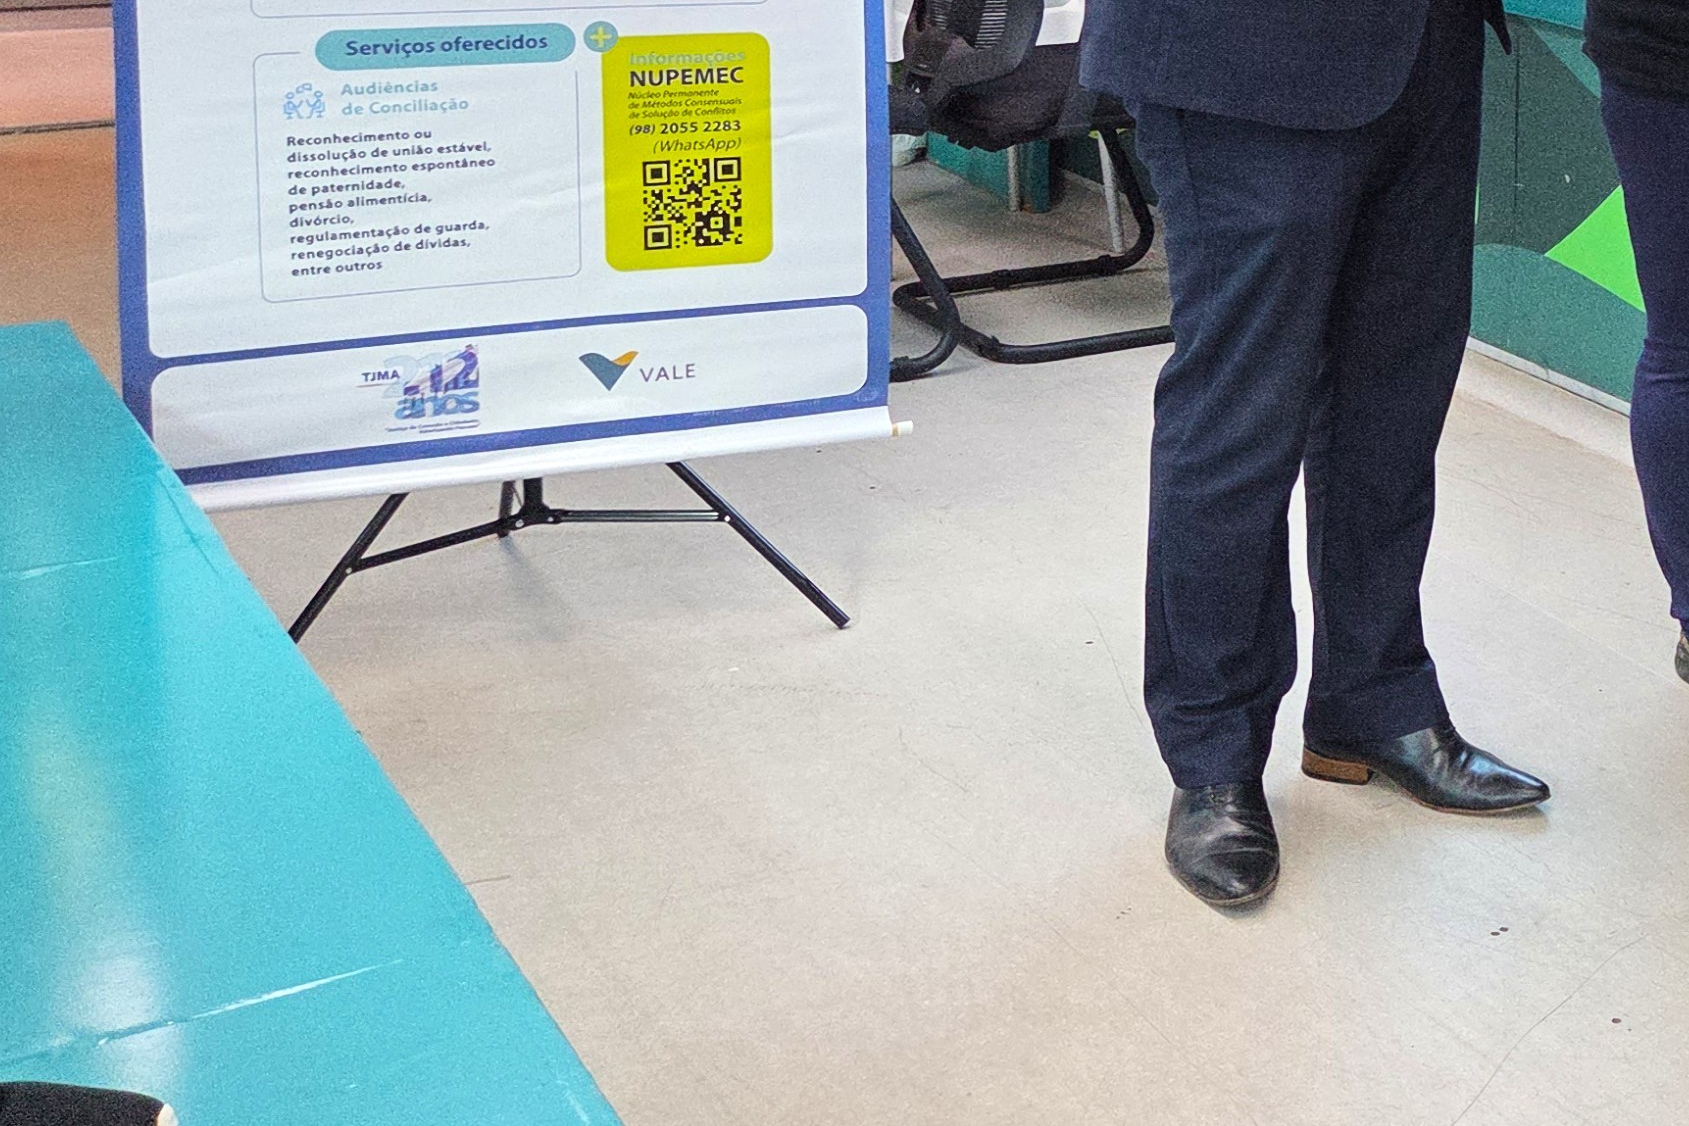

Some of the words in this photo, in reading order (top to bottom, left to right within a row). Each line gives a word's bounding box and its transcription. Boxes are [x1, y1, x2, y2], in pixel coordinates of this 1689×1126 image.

[345, 40, 436, 58] Serviços
[440, 35, 548, 53] oferecidos
[629, 49, 746, 67] Informações
[630, 66, 744, 87] NUPEMEC
[341, 79, 438, 97] Audiências
[628, 90, 661, 100] Núcleo
[663, 88, 720, 99] Permanente
[342, 101, 364, 116] de
[369, 97, 469, 116] Conciliação
[628, 101, 640, 109] de
[642, 98, 682, 109] Métodos
[684, 97, 742, 107] Consensuais
[629, 111, 640, 119] de
[642, 109, 680, 120] Solução
[682, 108, 693, 117] de
[695, 106, 737, 117] Conflitos
[629, 124, 656, 135] (98)
[661, 123, 698, 134] 2055
[703, 120, 741, 132] 2283
[287, 130, 410, 147] Reconhecimento
[413, 129, 432, 140] ou
[653, 137, 742, 154] (WhatsApp)
[287, 148, 366, 164] dissolução
[371, 147, 388, 159] de
[392, 144, 433, 157] união
[437, 141, 491, 154] estável,
[288, 162, 407, 179] reconhecimento
[412, 155, 496, 173] espontâneo
[288, 185, 307, 196] de
[311, 178, 405, 197] paternidade,
[289, 197, 343, 215] pensão
[347, 192, 432, 208] alimentícia,
[290, 213, 354, 228] divórcio,
[290, 225, 410, 246] regulamentação
[414, 223, 431, 234] de
[435, 220, 490, 235] guarda,
[291, 242, 390, 261] renegociação
[394, 240, 411, 252] de
[415, 237, 471, 250] dívidas,
[291, 264, 331, 276] entre
[335, 260, 383, 272] outros
[361, 369, 401, 382] TJMA
[639, 363, 697, 382] VALE
[394, 391, 480, 420] anos
